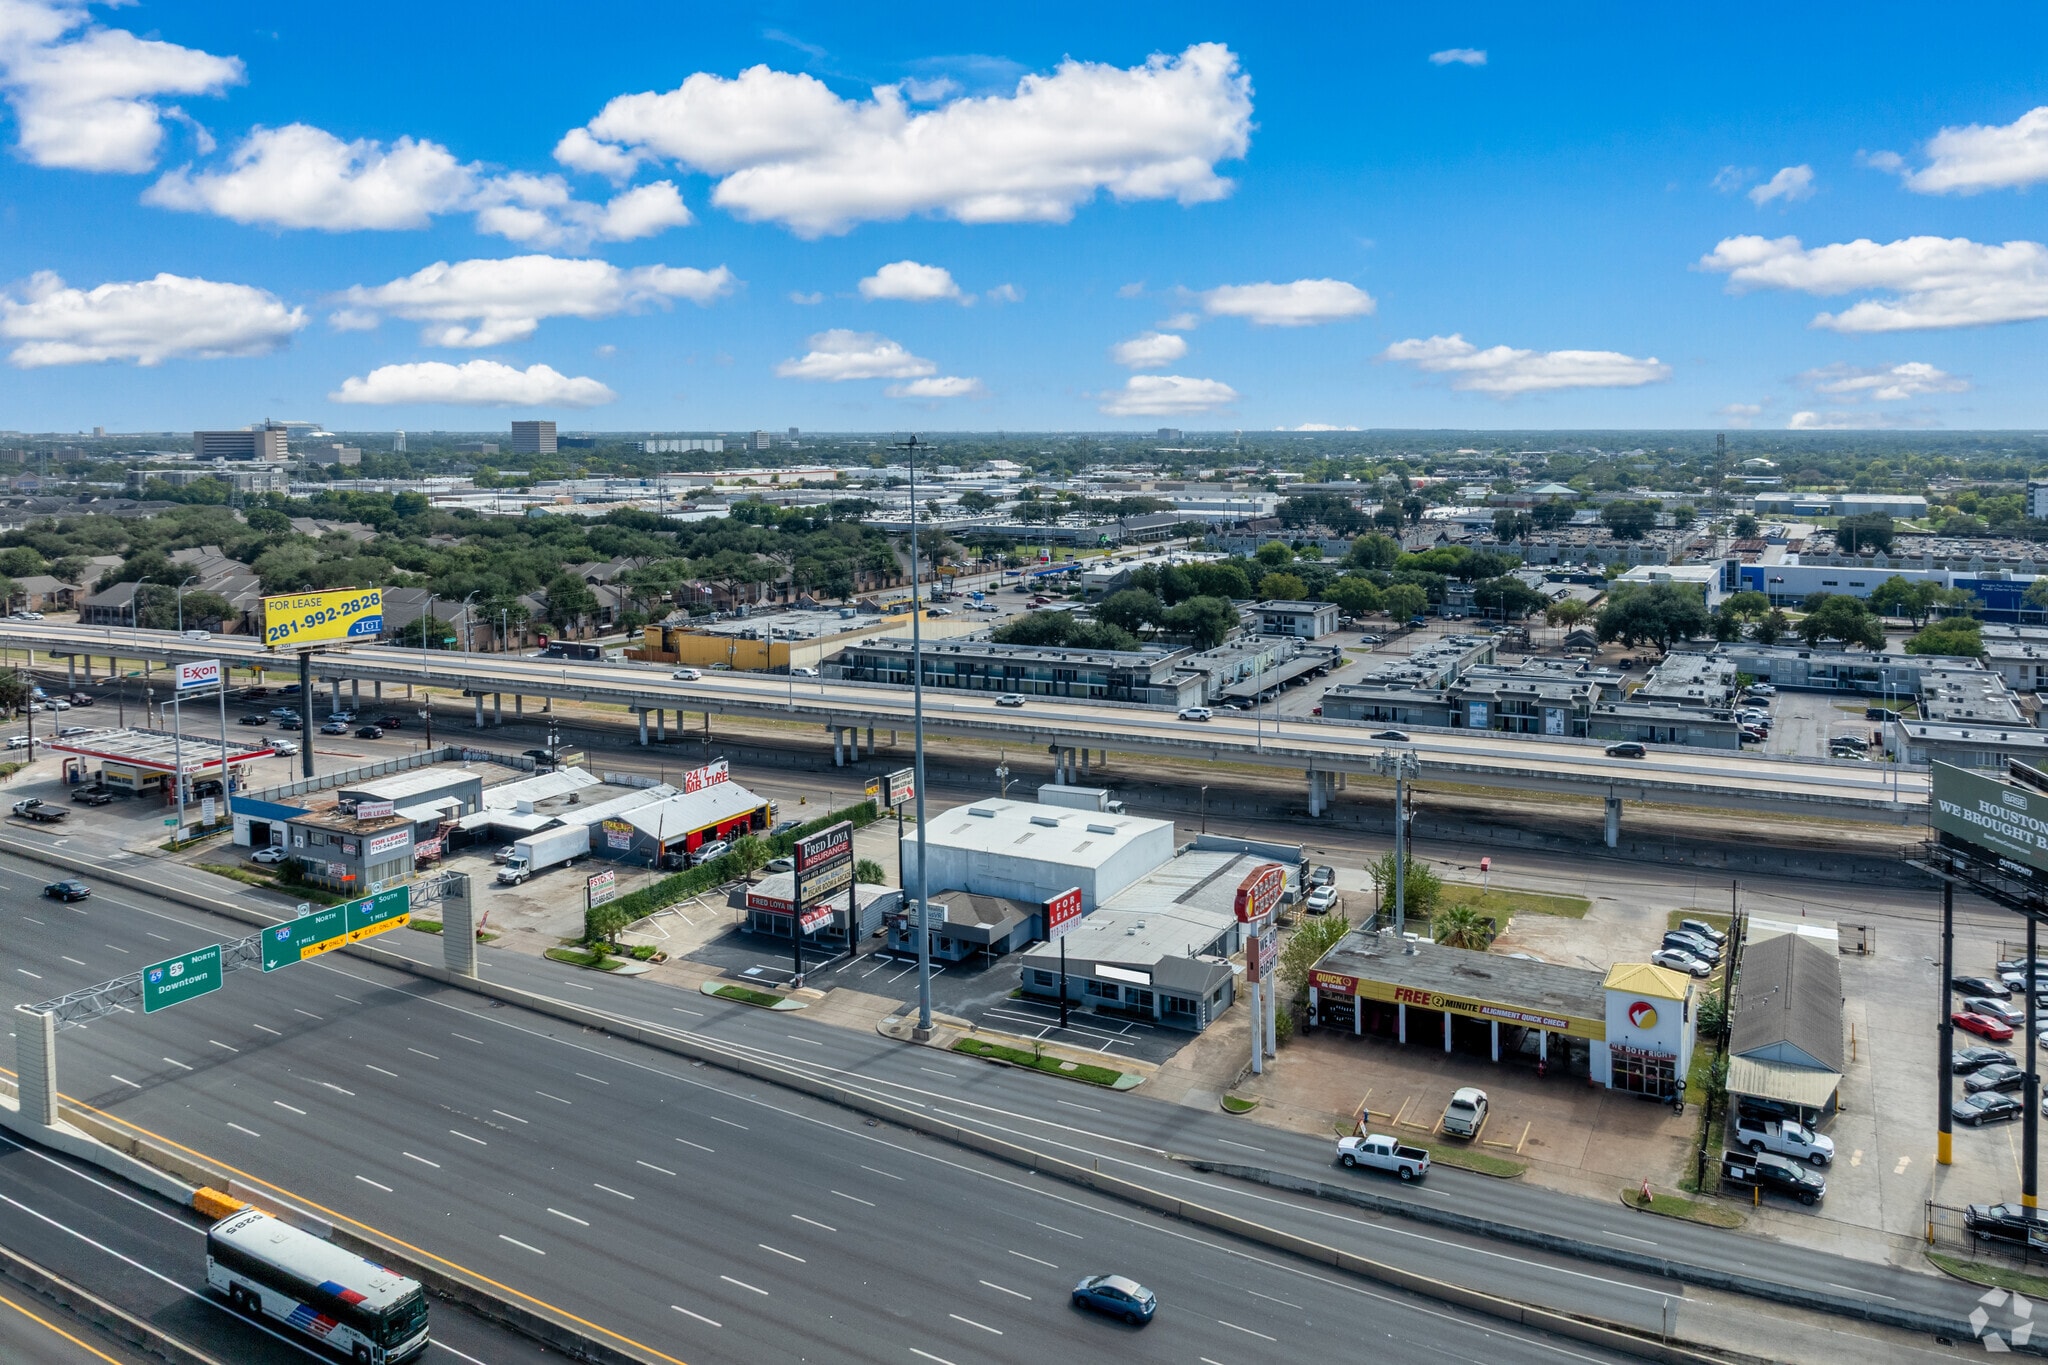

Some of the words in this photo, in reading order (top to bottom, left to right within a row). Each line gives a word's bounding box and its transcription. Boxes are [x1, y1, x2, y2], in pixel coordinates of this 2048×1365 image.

[269, 600, 289, 610] FOR
[292, 598, 322, 608] LEASE
[268, 592, 380, 642] 281-992-2828
[183, 666, 217, 680] Exxon
[686, 767, 709, 783] 24/7
[686, 780, 702, 794] MR
[704, 771, 728, 788] TIRE
[2004, 793, 2026, 808] BASE
[1938, 800, 1961, 818] WE
[1962, 808, 2034, 844] BROUGHT
[372, 838, 384, 846] FOR
[386, 832, 407, 842] LEASE
[804, 842, 826, 858] FRED
[827, 831, 848, 848] LOYA
[806, 843, 848, 866] INSURANCE
[1254, 870, 1278, 900] BRAKE
[378, 892, 398, 903] SOUTH
[752, 898, 768, 906] FRED
[770, 899, 785, 909] LOYA
[1056, 896, 1074, 912] FOR
[1254, 886, 1278, 916] CHECK
[361, 903, 374, 914] 610
[375, 912, 388, 920] MILE
[1050, 902, 1080, 924] LEASE
[316, 912, 336, 924] NORTH
[276, 931, 290, 941] 610
[364, 927, 376, 936] EXIT
[380, 922, 394, 930] ONLY
[302, 936, 316, 944] MILE
[303, 948, 316, 956] EXIT
[329, 938, 344, 948] ONLY
[1260, 934, 1268, 952] WE
[192, 952, 216, 964] NORTH
[171, 964, 182, 975] 59
[1260, 954, 1277, 978] RIGHT
[151, 972, 162, 982] 69
[158, 972, 208, 994] Downtown
[1316, 972, 1343, 985] QUICK
[1328, 983, 1346, 991] CHANGE
[1394, 988, 1432, 1006] FREE
[1444, 1000, 1478, 1012] MINUTE
[1482, 1006, 1520, 1020] ALIGNMENT
[1522, 1014, 1542, 1024] QUICK
[1543, 1018, 1566, 1028] CHECK
[1611, 1042, 1622, 1050] WE
[1648, 1050, 1676, 1058] RIGHT
